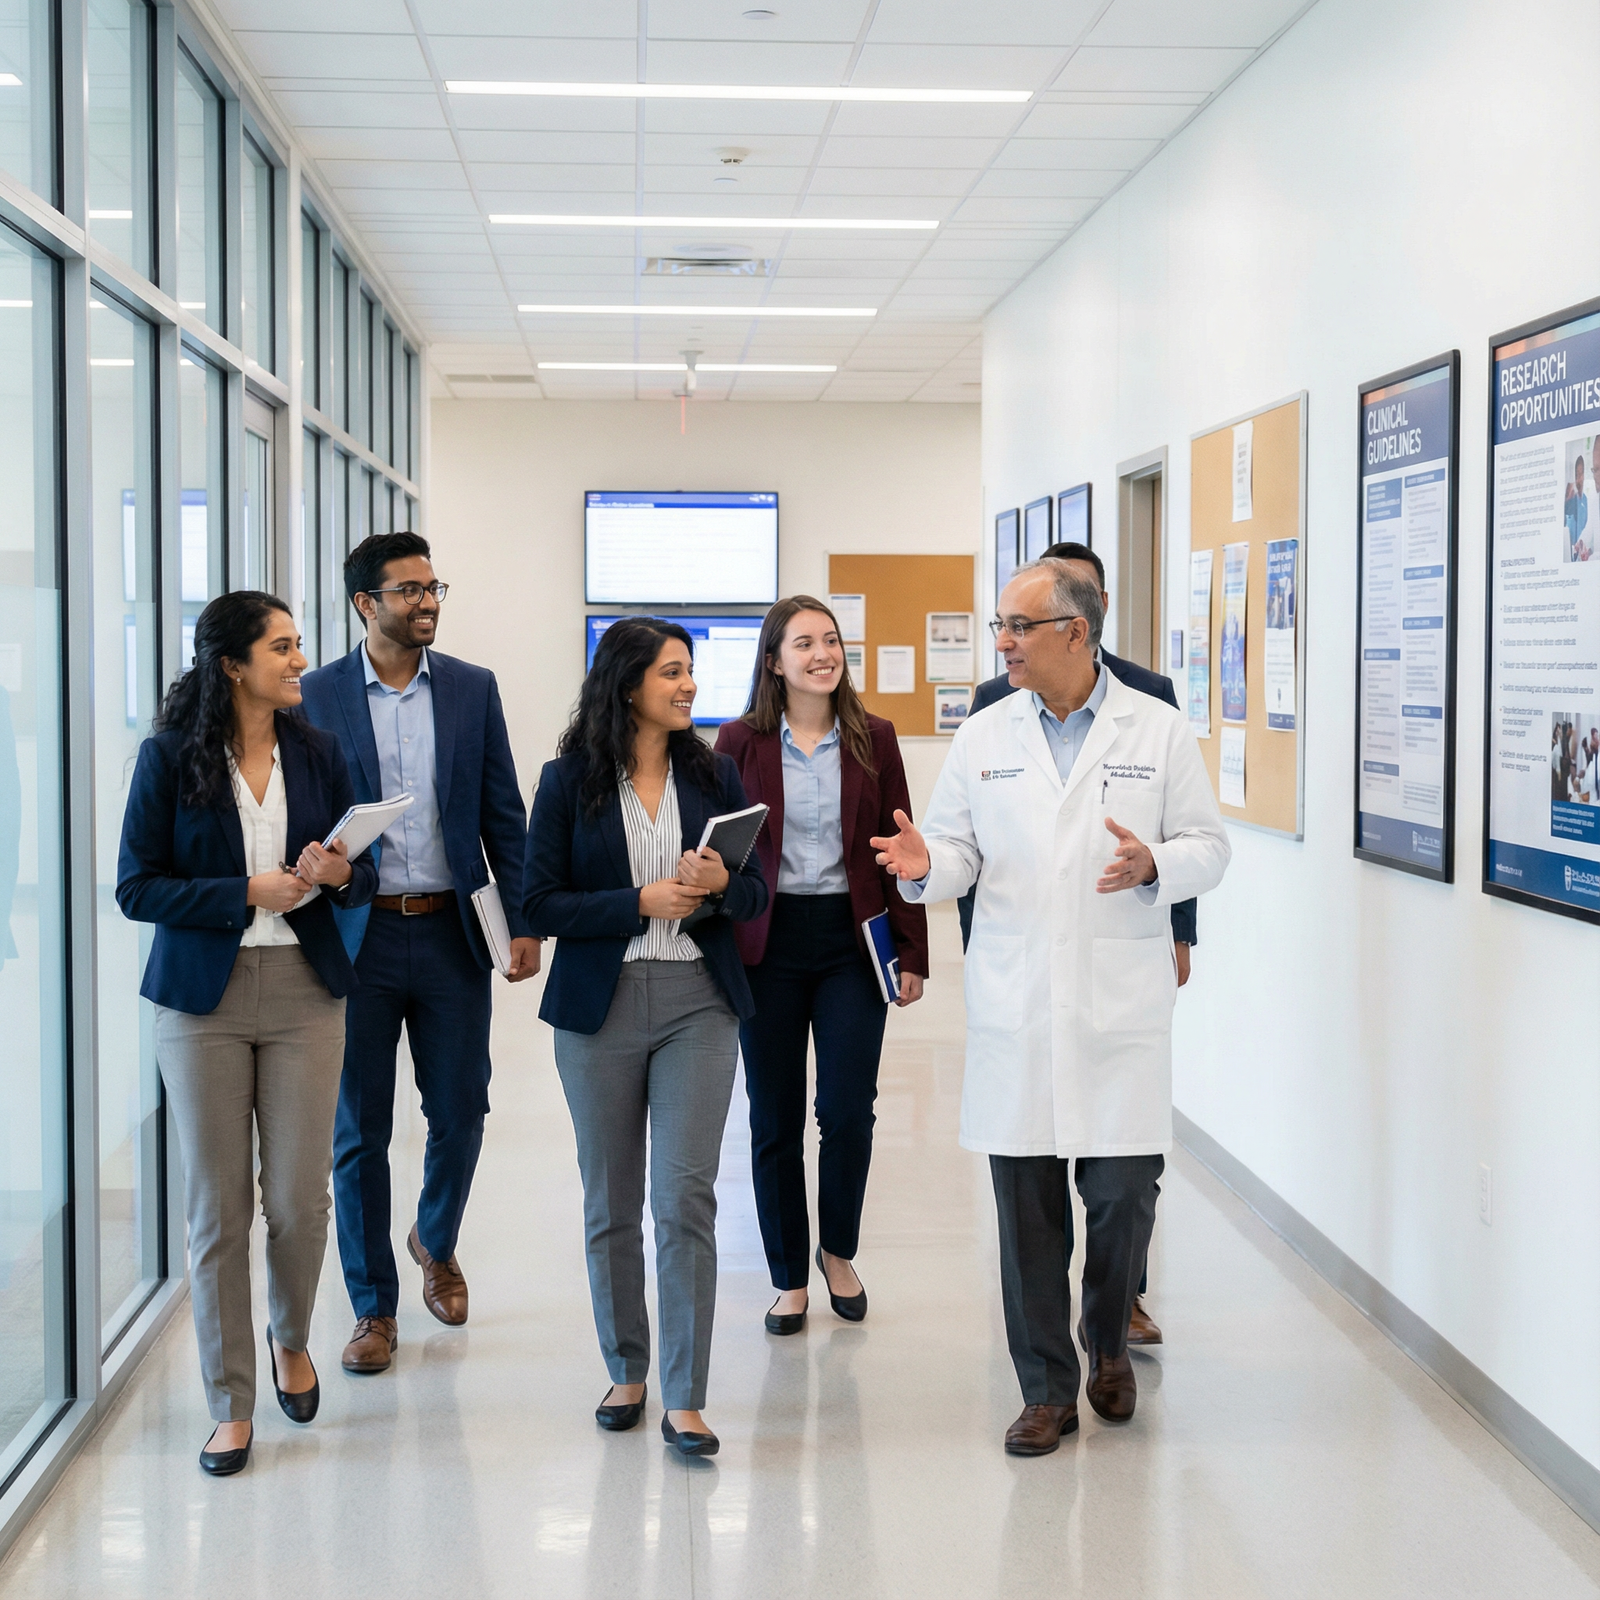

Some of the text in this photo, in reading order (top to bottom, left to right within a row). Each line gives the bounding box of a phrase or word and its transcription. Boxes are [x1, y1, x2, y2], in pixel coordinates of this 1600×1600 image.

[1501, 350, 1566, 397] RESEARCH
[1367, 401, 1409, 436] CLINICAL
[1500, 377, 1600, 431] OPPORTUNITIES
[1367, 427, 1422, 465] GUIDELINES
